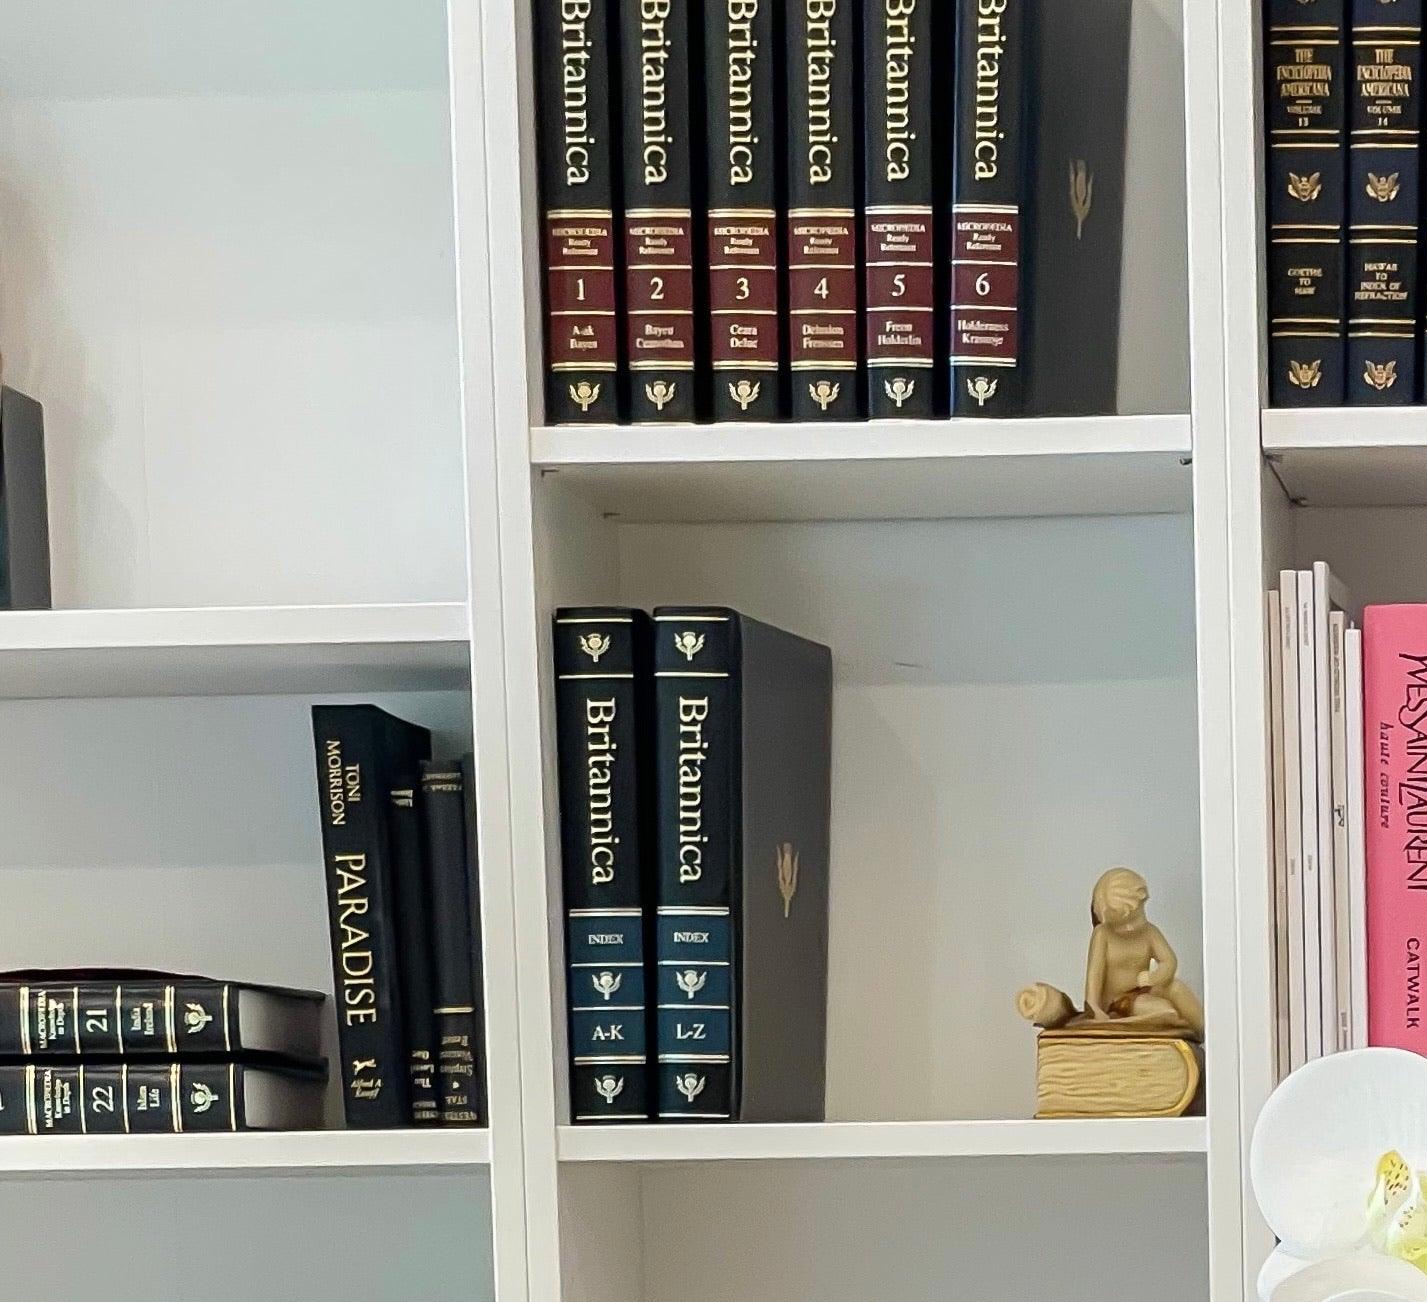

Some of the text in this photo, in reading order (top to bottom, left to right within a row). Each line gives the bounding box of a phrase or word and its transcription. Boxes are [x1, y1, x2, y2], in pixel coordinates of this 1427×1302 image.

[562, 0, 596, 186] Britannica
[640, 0, 674, 186] Britannica
[727, 0, 760, 187] Britannica
[806, 0, 839, 185] Britannica
[883, 0, 917, 183] Britannica
[974, 0, 1007, 181] Britannica
[576, 278, 586, 301] 1
[650, 276, 665, 300] 2
[735, 277, 750, 300] 3
[813, 277, 829, 299] 4
[890, 273, 906, 297] 5
[975, 272, 991, 296] 6
[327, 739, 346, 826] MORRISON
[345, 762, 361, 802] TONI
[585, 697, 620, 885] Britannica
[678, 695, 709, 884] Britannica
[1379, 721, 1391, 830] haute couture
[334, 852, 377, 1027] PARADISE
[588, 933, 624, 945] INDEX
[673, 931, 709, 944] INDEX
[1405, 937, 1421, 1029] CATWALK
[86, 1008, 109, 1034] 21
[591, 1024, 625, 1041] A-K
[676, 1023, 706, 1040] L-Z
[92, 1085, 114, 1114] 22
